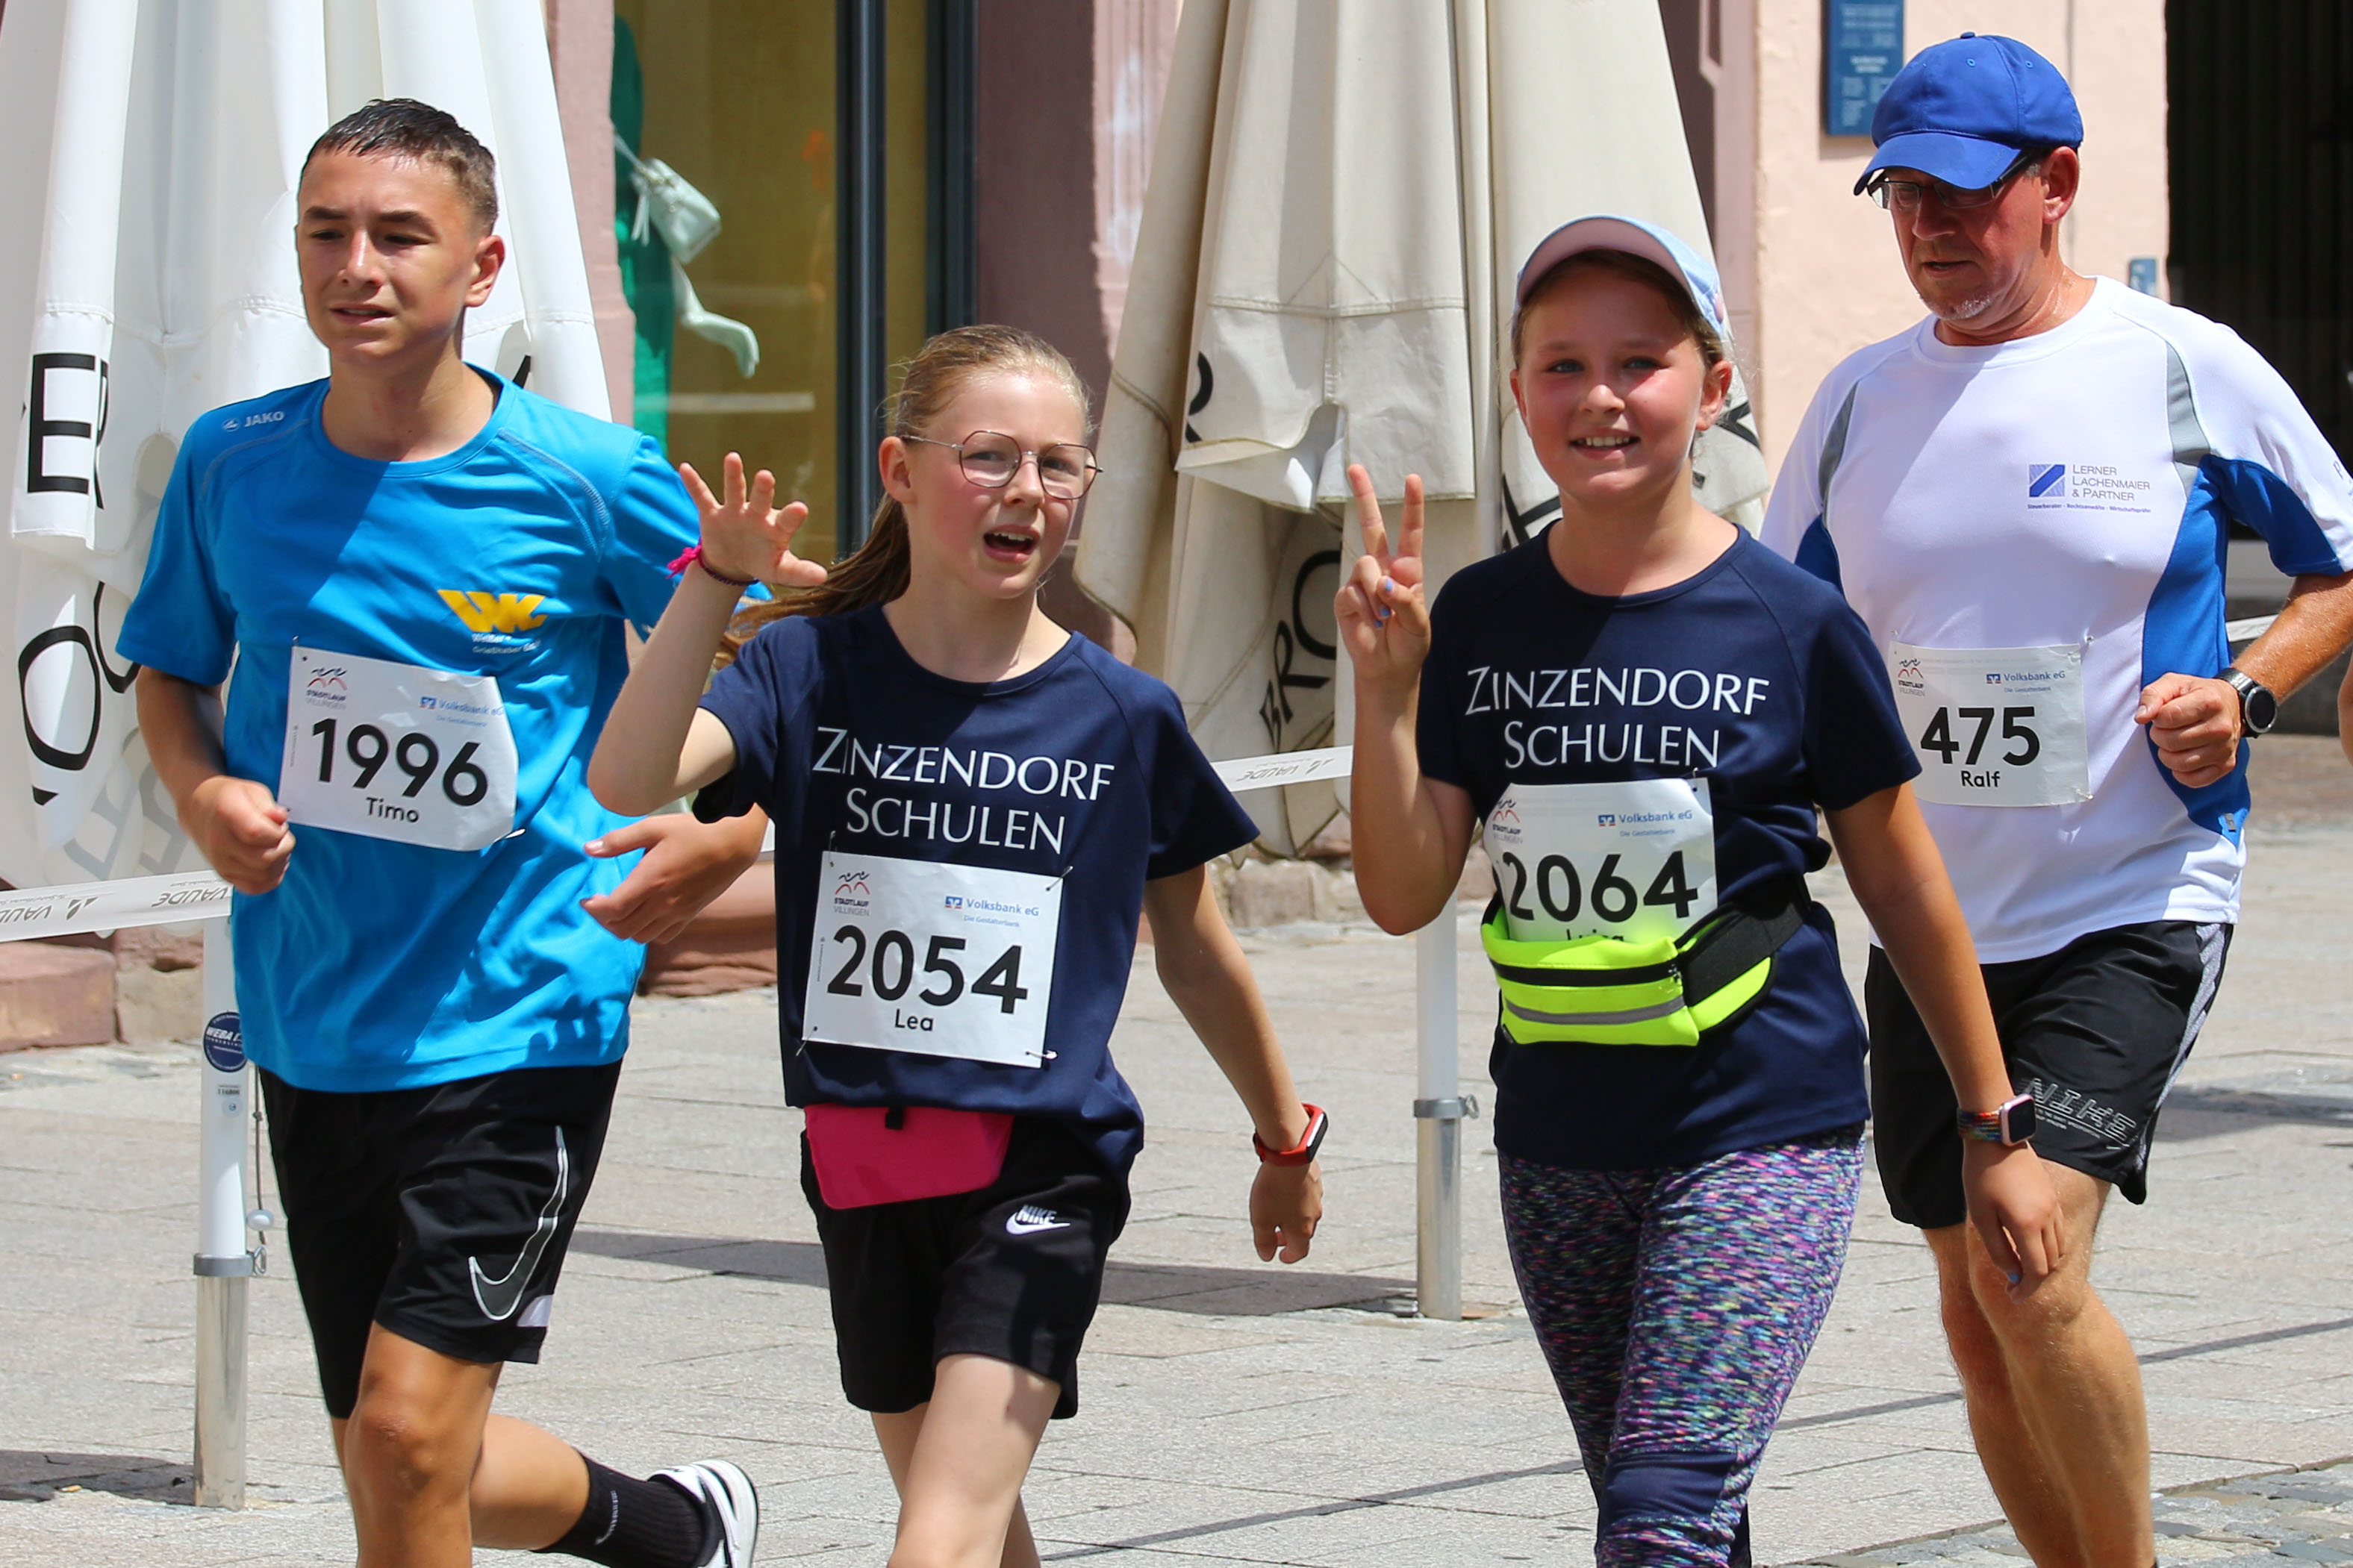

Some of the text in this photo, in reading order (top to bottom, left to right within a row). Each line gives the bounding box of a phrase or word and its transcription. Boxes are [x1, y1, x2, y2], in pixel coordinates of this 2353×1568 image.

[244, 410, 285, 428] JAKO
[2072, 464, 2117, 476] LERNER
[2072, 476, 2151, 490] LACHENMAIER
[2072, 489, 2135, 501] & PARTNER
[2003, 670, 2066, 681] Volksbank eG
[1921, 706, 2040, 766] 475
[311, 718, 489, 807] 1996
[1961, 770, 2001, 788] Ralf
[366, 797, 420, 824] Timo
[1618, 809, 1693, 823] Volksbank eG
[1503, 849, 1698, 923] 2064
[151, 887, 228, 908] VAUDE
[966, 898, 1040, 916] Volksbank eG
[826, 924, 1028, 1014] 2054
[894, 1009, 934, 1032] Lea
[2022, 1077, 2137, 1143] NIKE
[1016, 1204, 1058, 1225] NIKE
